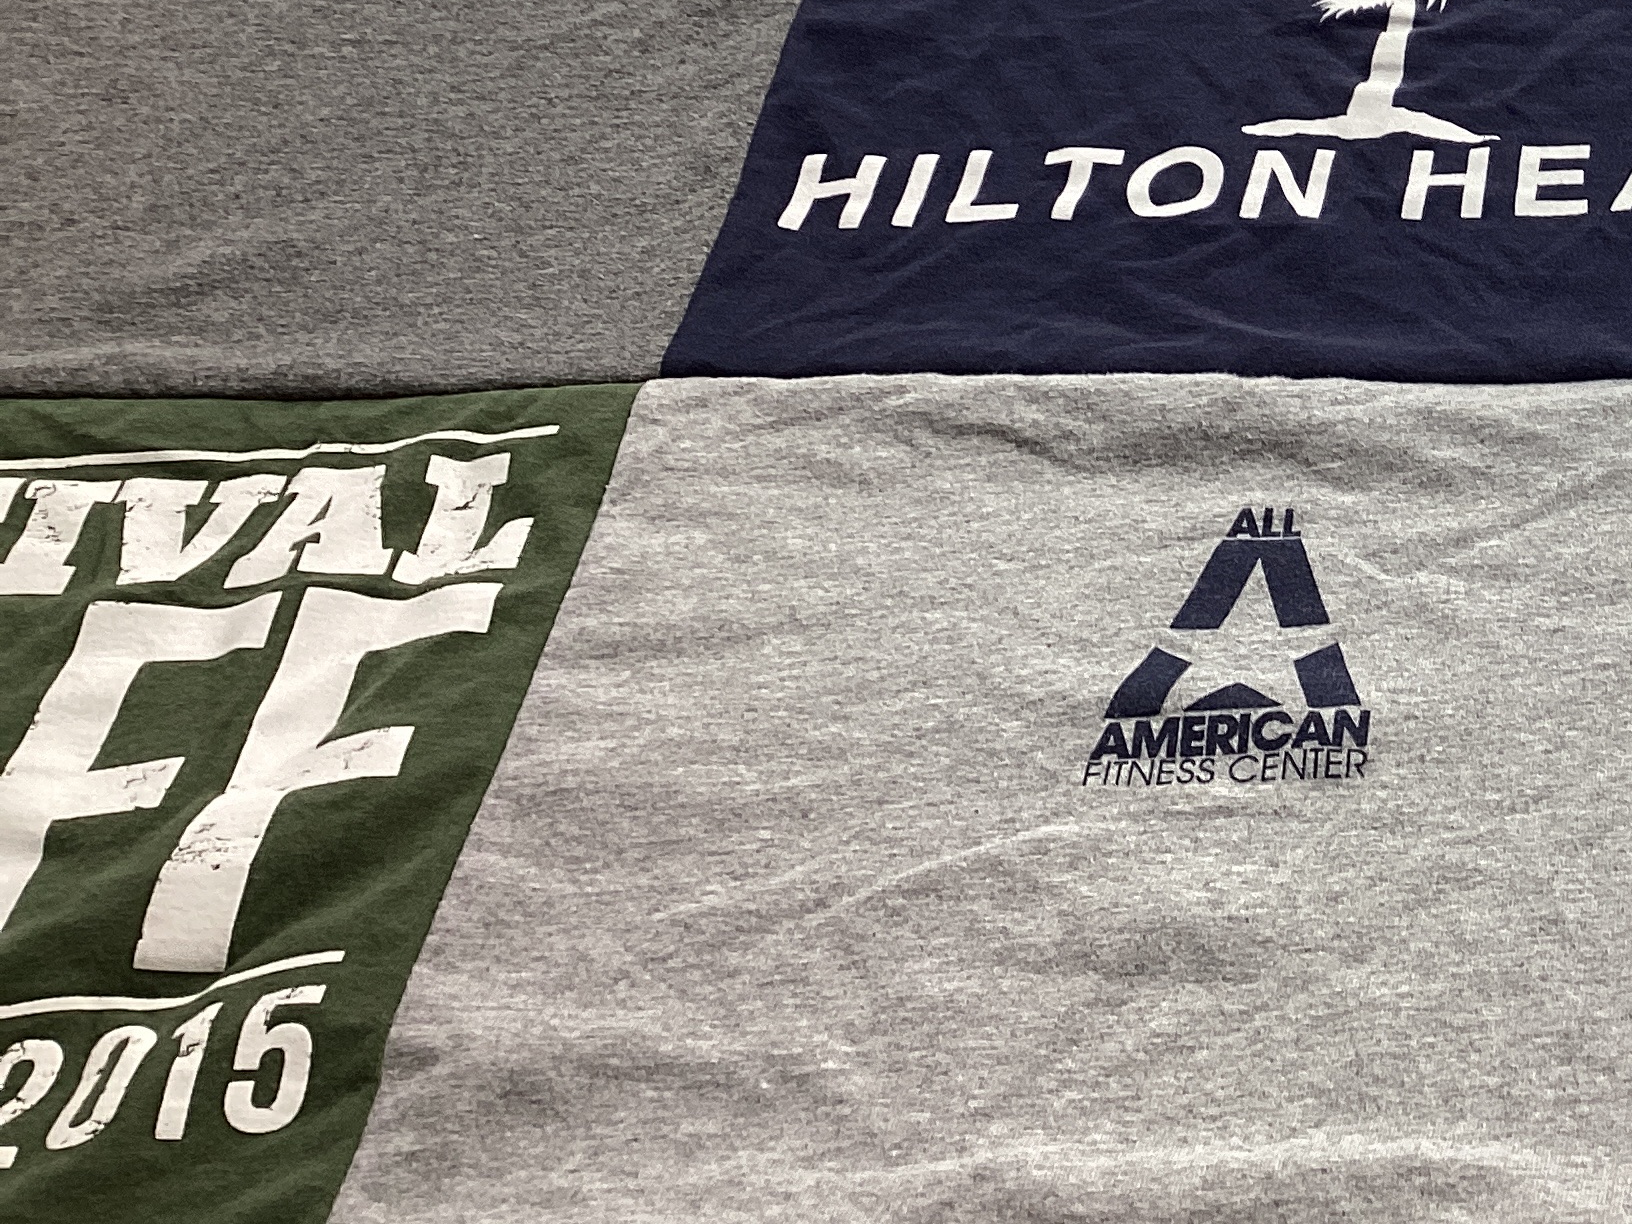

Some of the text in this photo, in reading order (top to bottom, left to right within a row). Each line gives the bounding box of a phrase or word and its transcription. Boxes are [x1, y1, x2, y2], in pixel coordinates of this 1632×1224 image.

[778, 146, 1336, 230] HILTON
[1225, 507, 1301, 538] ALL
[1088, 709, 1371, 760] AMERICAN
[1082, 747, 1370, 786] FITNESS CENTER
